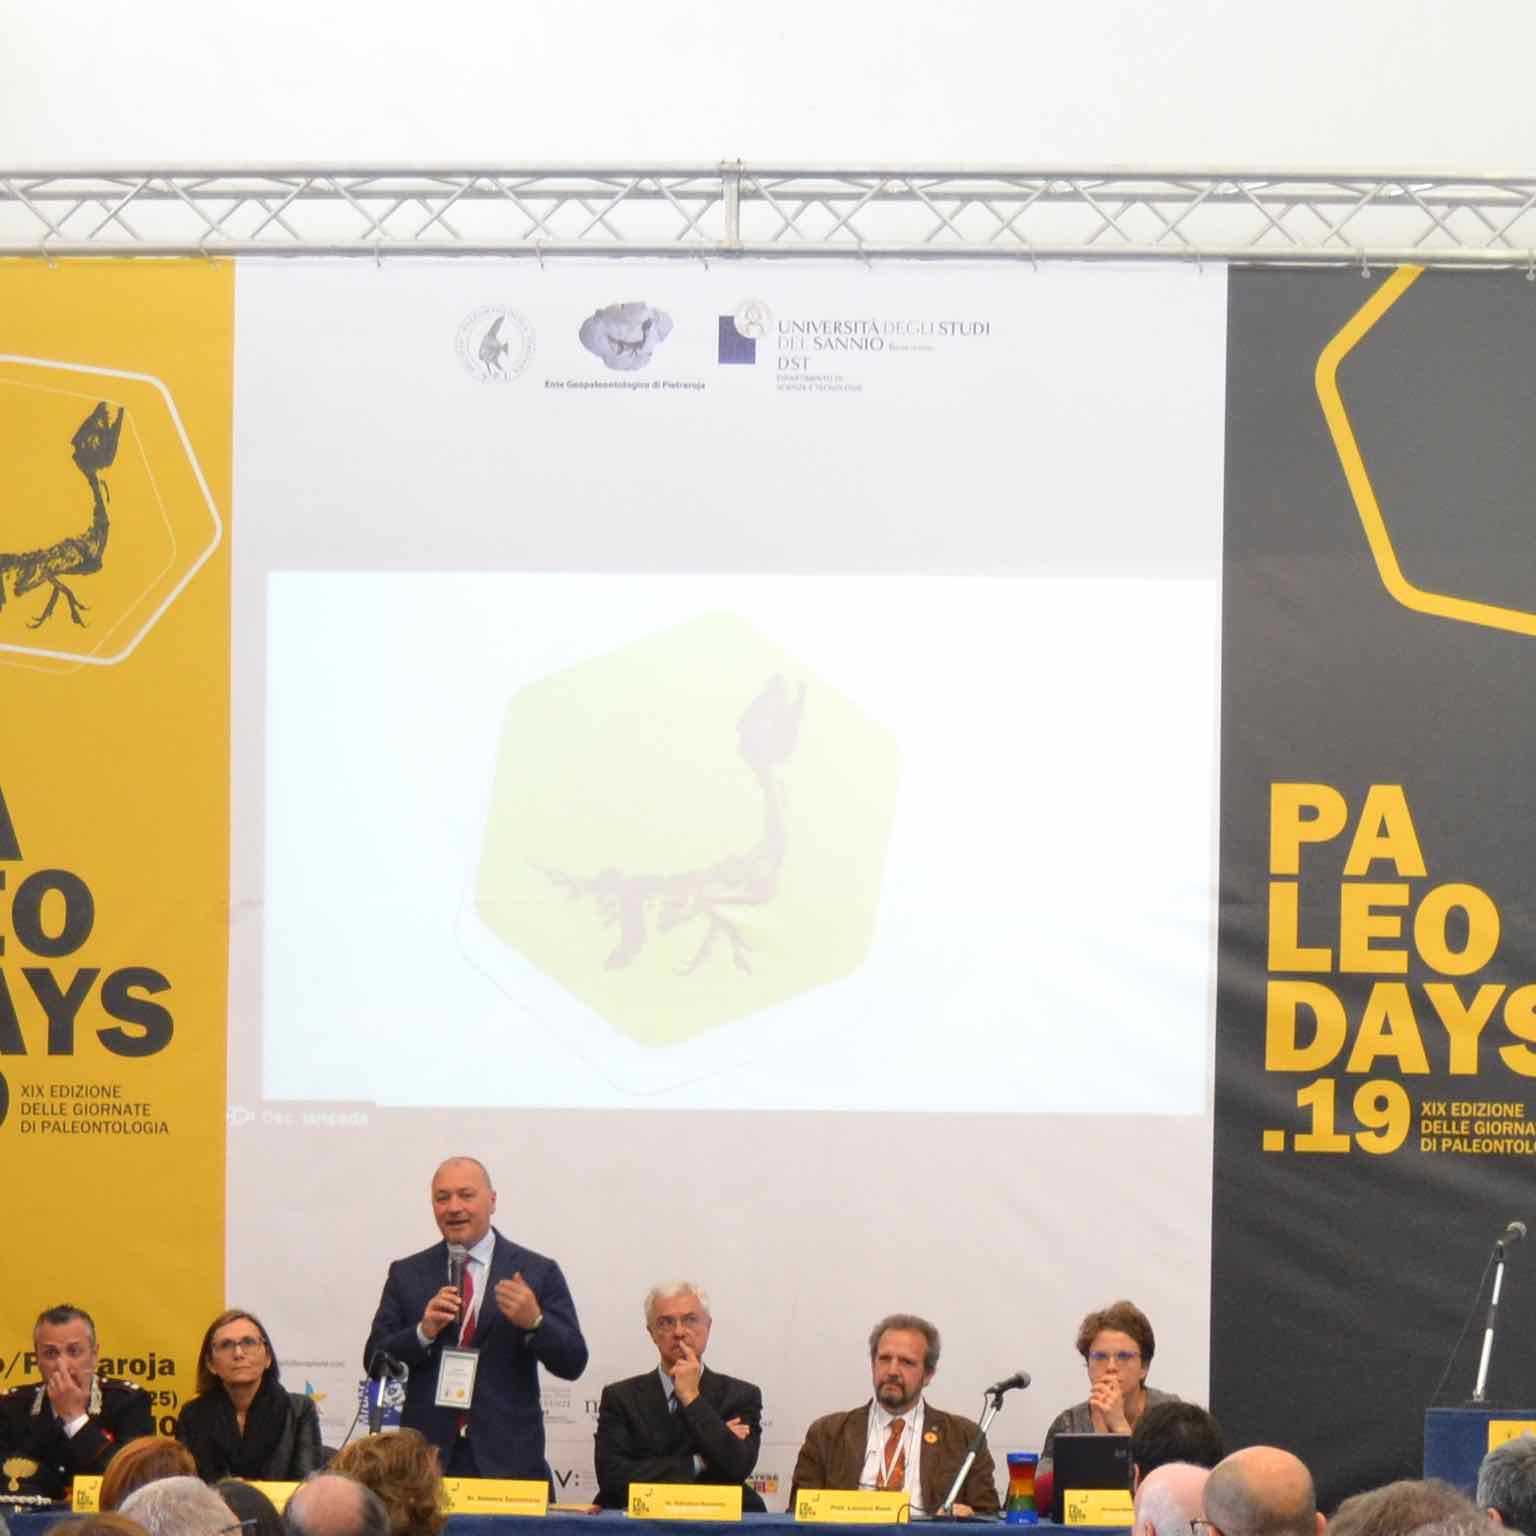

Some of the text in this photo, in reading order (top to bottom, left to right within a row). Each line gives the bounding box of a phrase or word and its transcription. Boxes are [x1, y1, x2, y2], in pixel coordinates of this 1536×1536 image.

[777, 317, 880, 335] UNIVERSITÀ
[938, 320, 991, 336] STUDI
[813, 336, 885, 351] SANNIO
[777, 356, 809, 370] DST
[1268, 783, 1428, 877] PA
[1267, 882, 1501, 977] LEO
[20, 1085, 121, 1099] XIX EDIZIONE
[20, 1102, 151, 1117] DELLE GIORNATE
[1421, 1102, 1525, 1118] XIX EDIZIONE
[1263, 1080, 1412, 1155] .19
[20, 1120, 169, 1134] DI PALEONTOLOGIA
[1420, 1120, 1471, 1135] DELLE
[1420, 1137, 1437, 1153] DI
